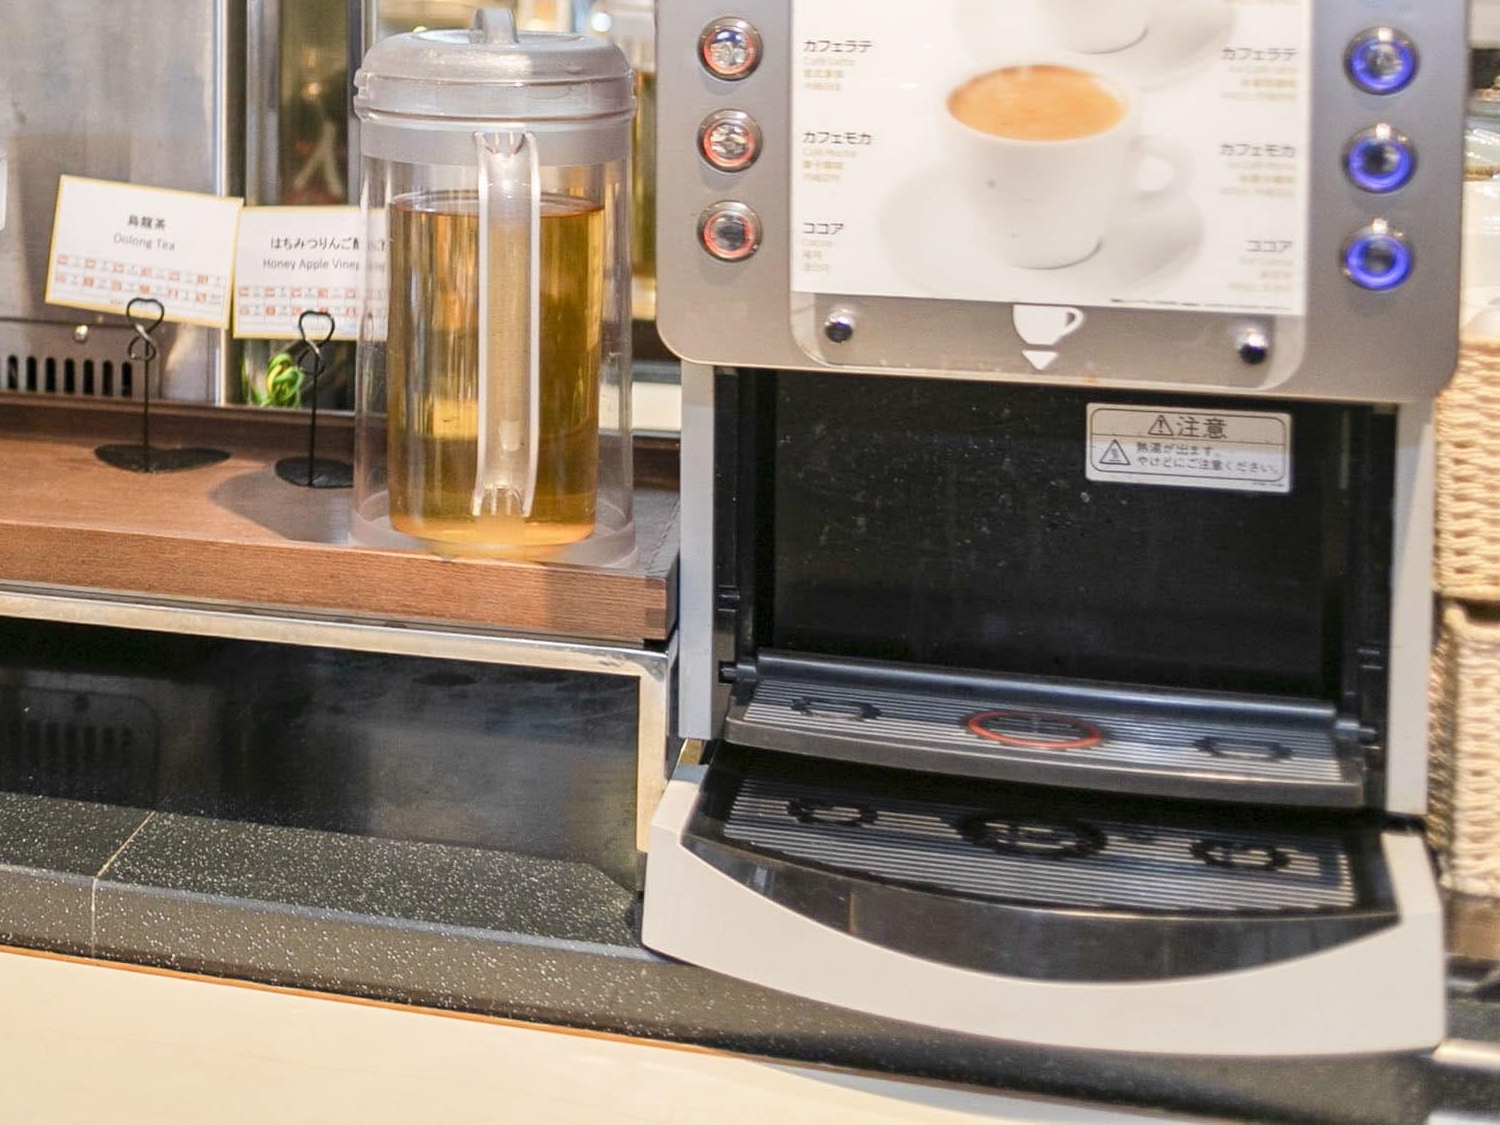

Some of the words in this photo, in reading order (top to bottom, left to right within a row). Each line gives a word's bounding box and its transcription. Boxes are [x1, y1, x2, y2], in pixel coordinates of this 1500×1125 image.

[803, 39, 874, 54] カフェラテ
[1220, 47, 1298, 62] カフェラテ
[803, 131, 872, 146] カフェモカ
[1219, 143, 1297, 158] カフェモカ
[802, 222, 845, 236] ココア
[156, 238, 177, 251] Tea
[1247, 240, 1293, 254] ココア
[263, 258, 296, 272] Honey
[299, 258, 330, 271] Apple
[1175, 415, 1229, 440] 注意
